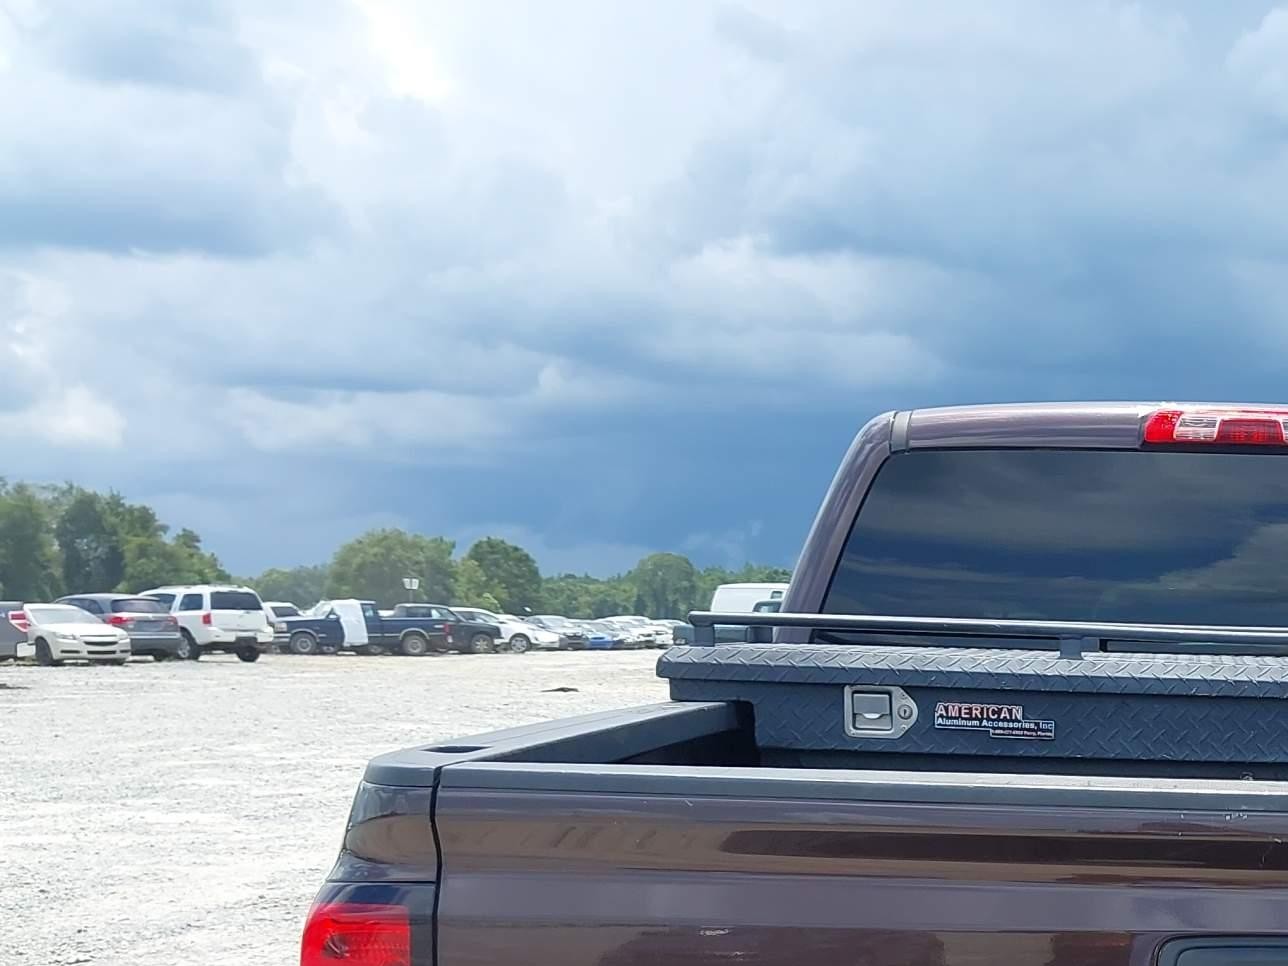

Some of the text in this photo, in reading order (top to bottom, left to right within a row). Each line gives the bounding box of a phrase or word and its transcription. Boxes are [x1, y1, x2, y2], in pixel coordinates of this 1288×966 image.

[936, 704, 1021, 720] AMERICAN
[937, 718, 980, 727] Aluminum
[981, 720, 1038, 730] Accessories,
